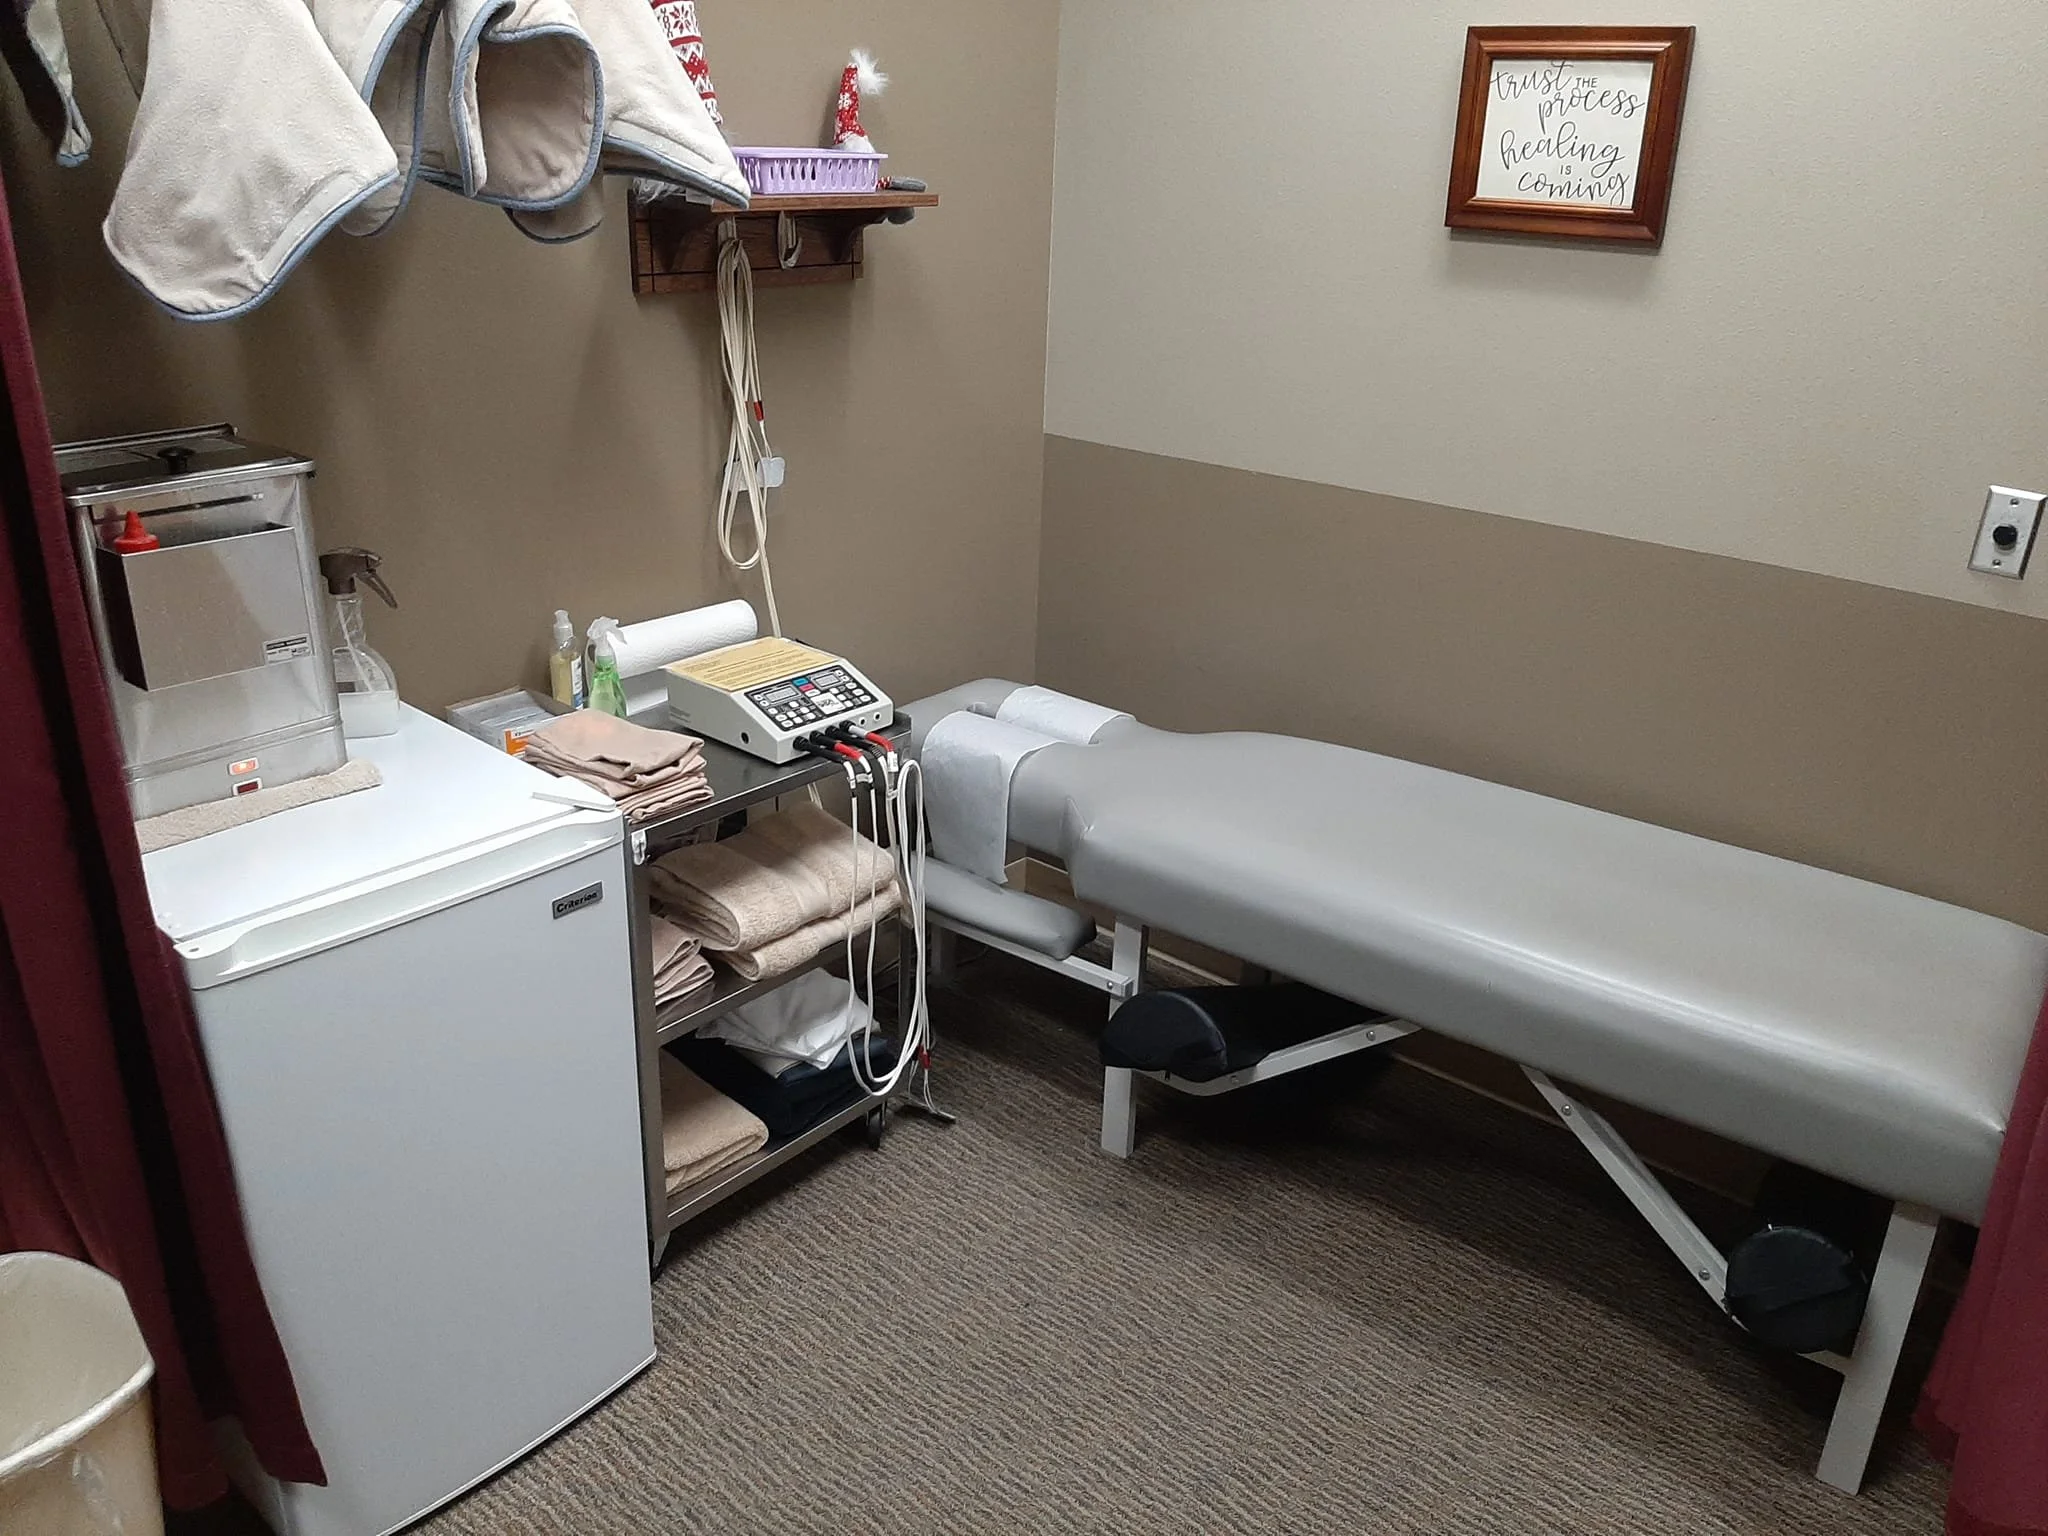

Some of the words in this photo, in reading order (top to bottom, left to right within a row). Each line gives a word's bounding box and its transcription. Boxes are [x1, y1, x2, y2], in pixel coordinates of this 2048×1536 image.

[1490, 60, 1572, 101] trust
[1575, 77, 1598, 88] THE
[1538, 87, 1646, 135] process
[1500, 121, 1626, 179] healing
[1560, 164, 1572, 175] IS
[1517, 171, 1630, 206] coming
